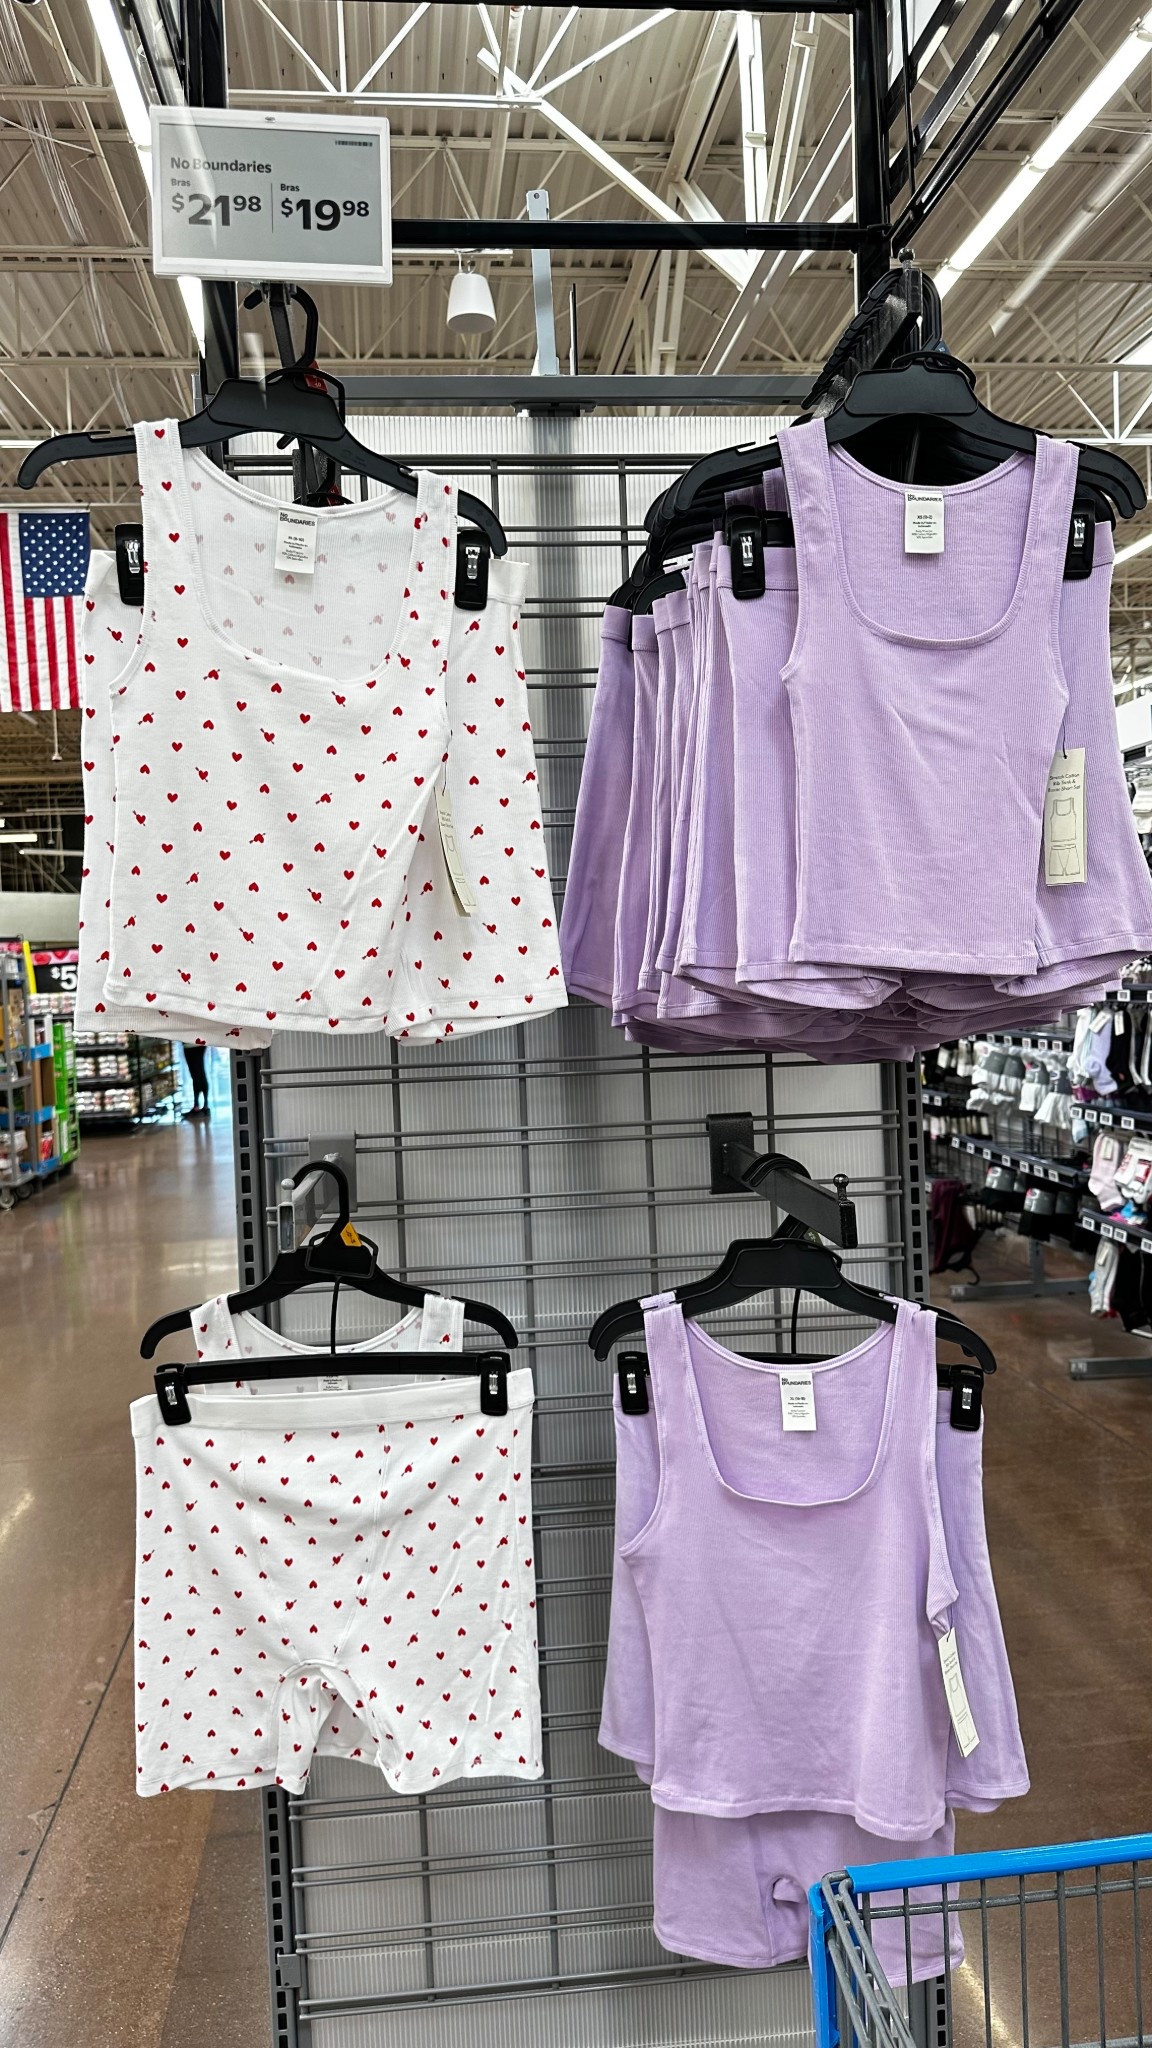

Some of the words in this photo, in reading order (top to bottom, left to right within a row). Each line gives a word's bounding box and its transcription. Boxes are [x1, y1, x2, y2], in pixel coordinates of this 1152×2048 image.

[170, 157, 190, 170] No
[193, 158, 272, 174] Boundaries
[171, 178, 191, 188] Bras
[280, 183, 300, 192] Bras
[51, 964, 78, 990] $5
